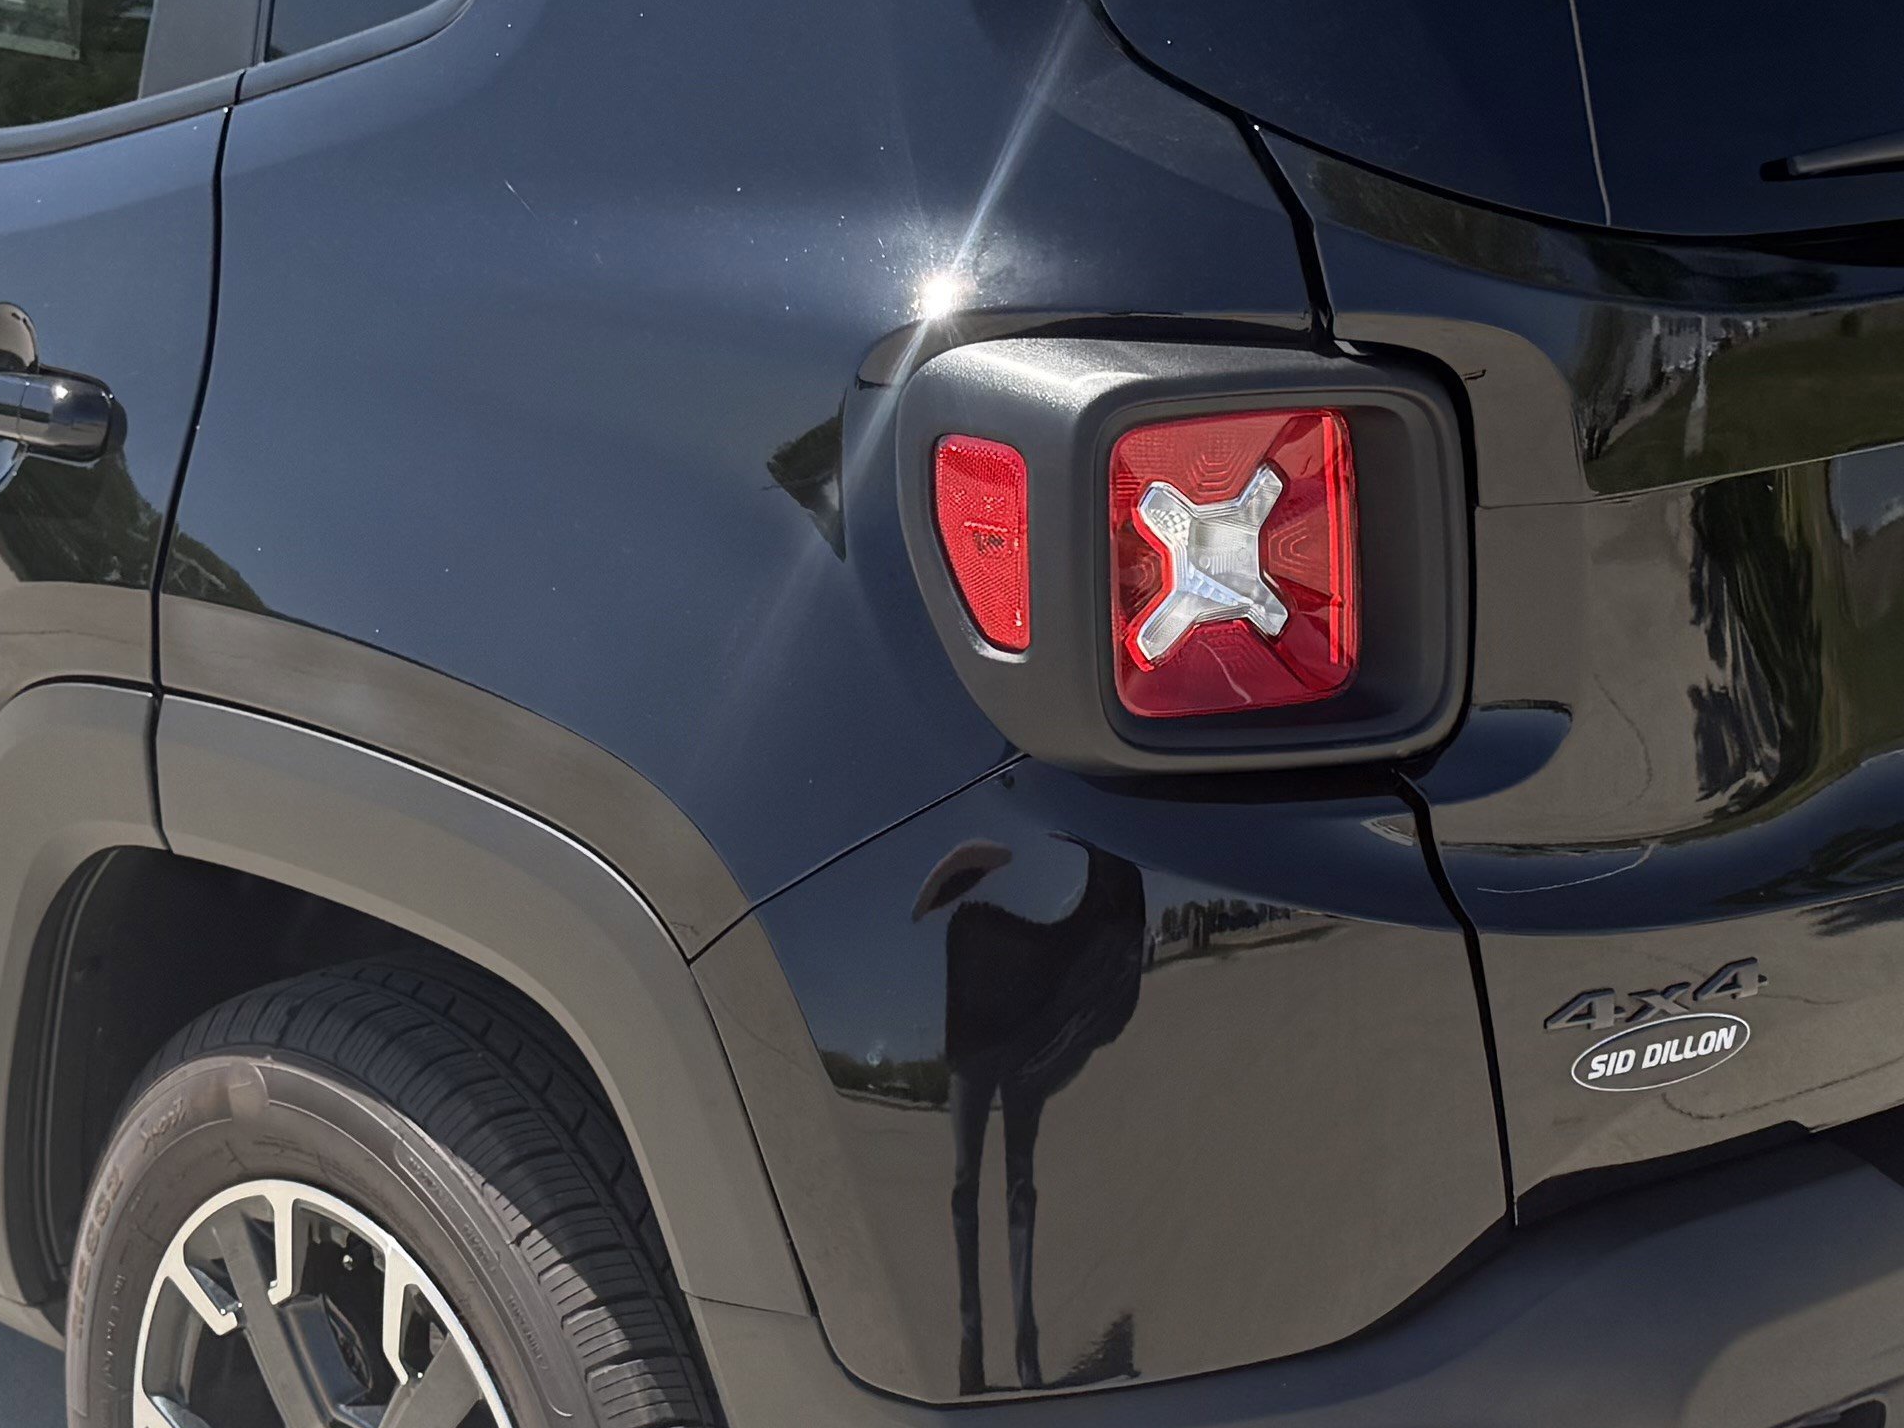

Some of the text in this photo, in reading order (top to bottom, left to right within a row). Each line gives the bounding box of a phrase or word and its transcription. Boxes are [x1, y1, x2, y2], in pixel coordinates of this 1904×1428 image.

[1543, 956, 1768, 1030] 4x4
[1588, 1025, 1737, 1080] SID DILLON
